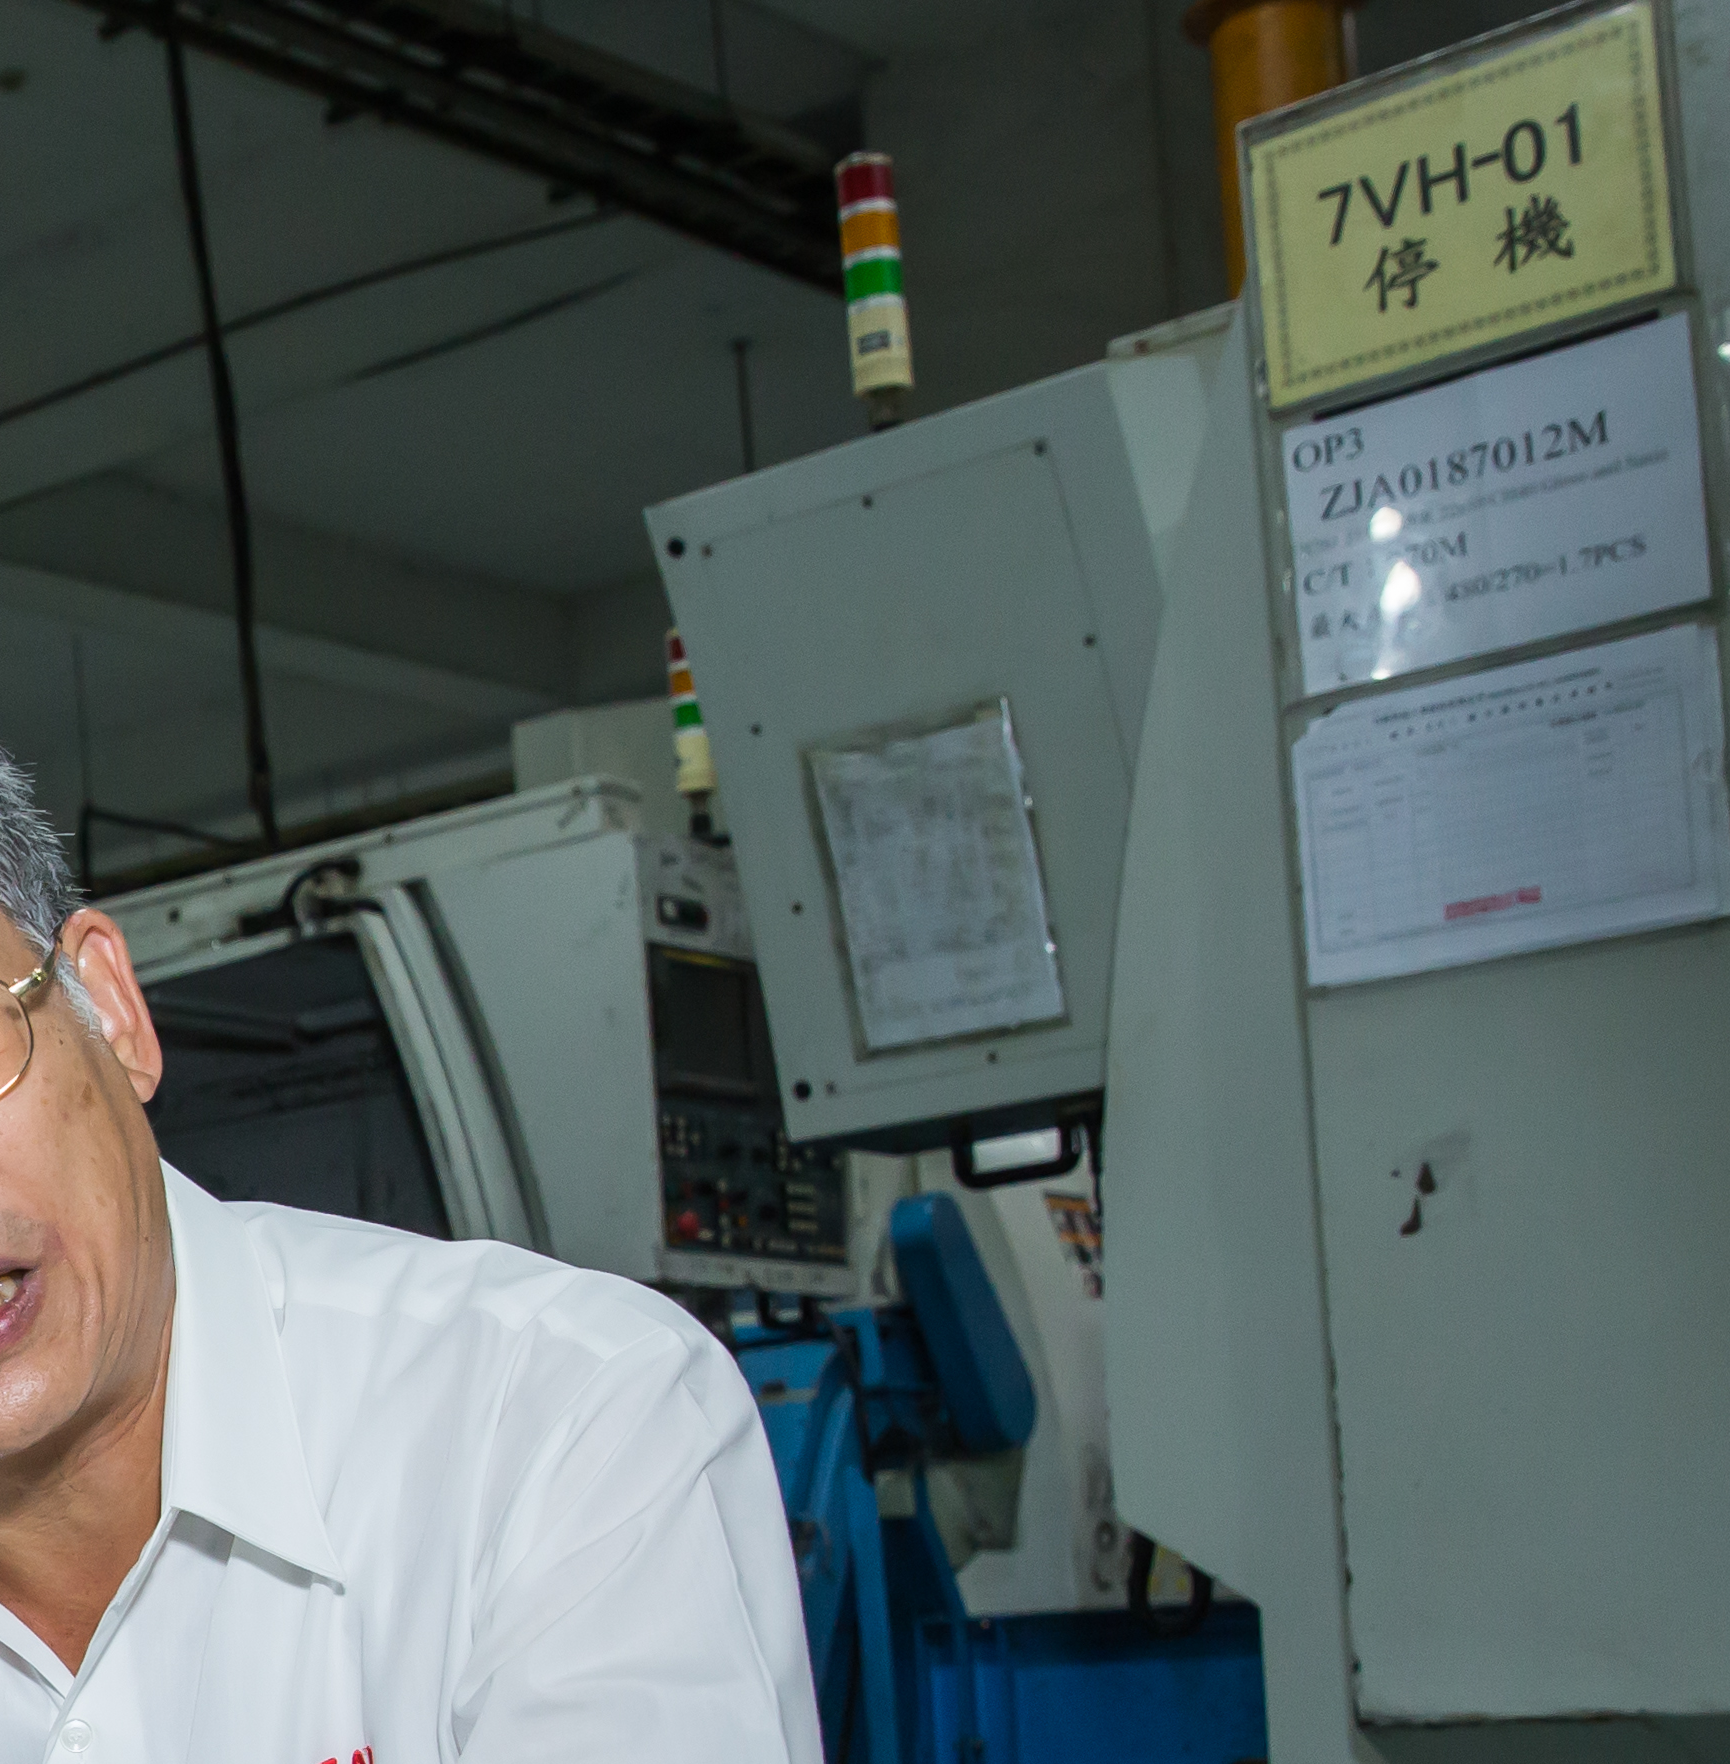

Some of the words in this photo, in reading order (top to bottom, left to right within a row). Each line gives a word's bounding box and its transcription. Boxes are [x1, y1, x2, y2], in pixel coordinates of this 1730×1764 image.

[1318, 101, 1583, 247] 7VH-01
[1292, 426, 1366, 474] OP3
[1320, 409, 1610, 522] ZJA0187012M
